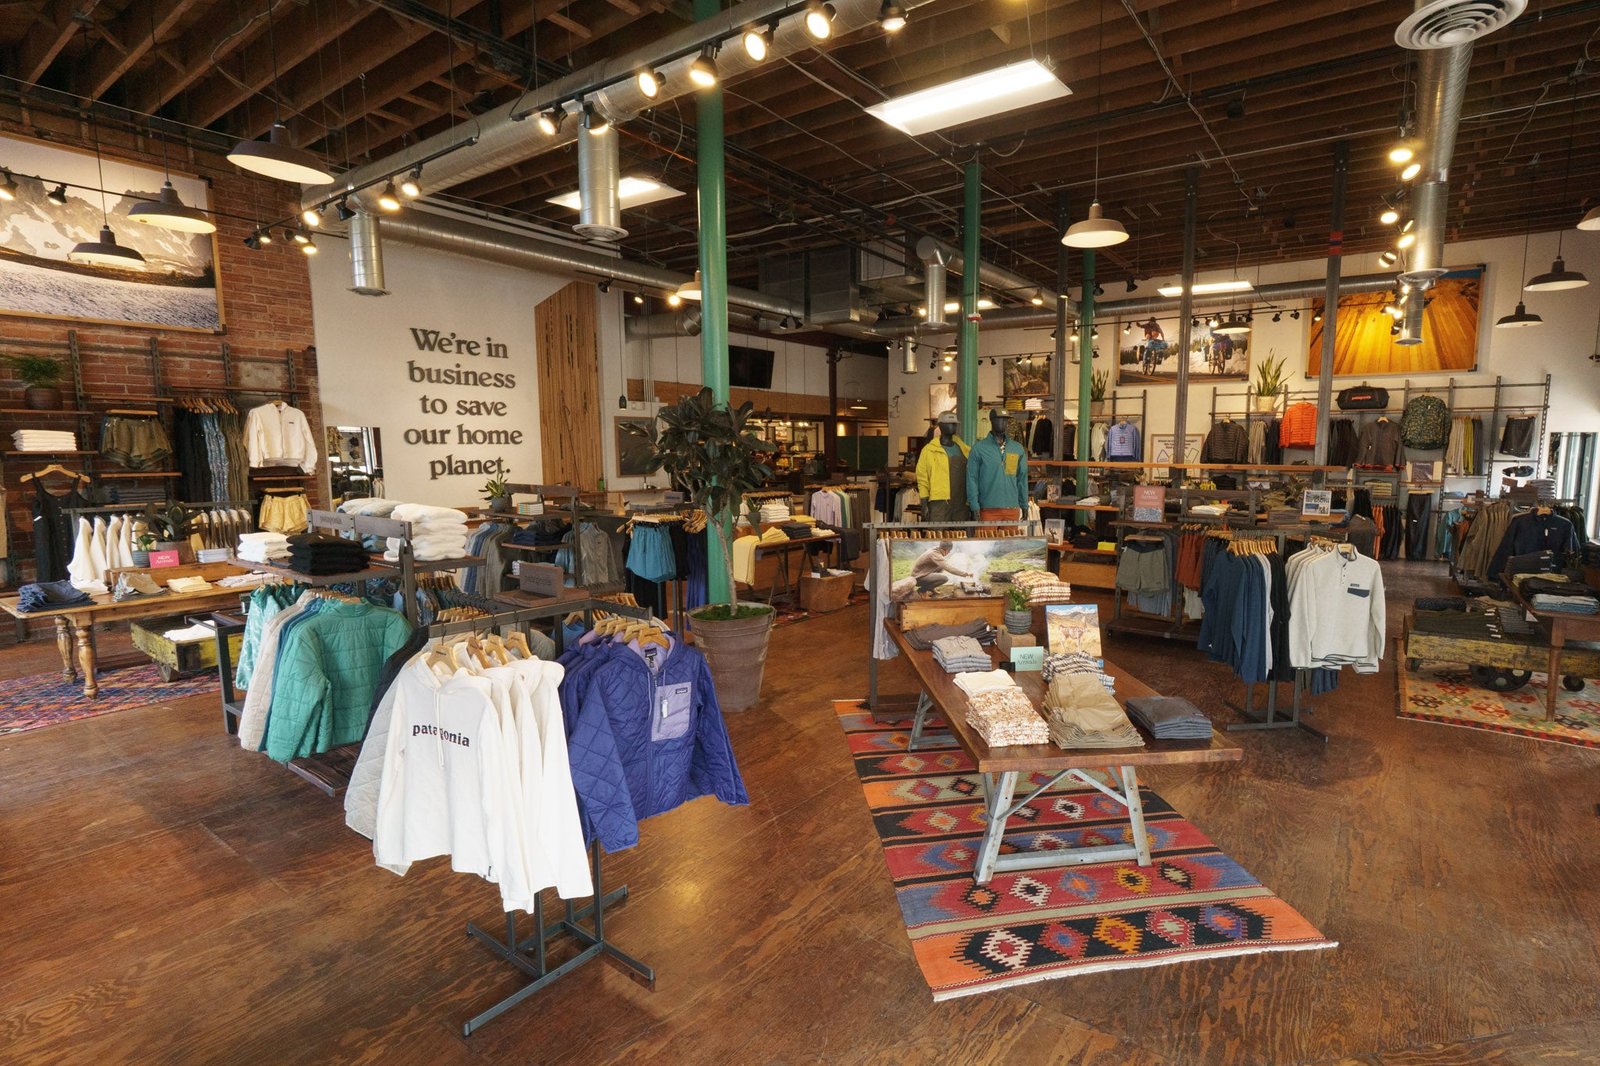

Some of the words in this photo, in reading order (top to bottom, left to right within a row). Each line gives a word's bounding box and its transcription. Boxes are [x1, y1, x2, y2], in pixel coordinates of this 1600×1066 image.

[410, 328, 480, 356] We're
[486, 337, 508, 359] in
[407, 360, 516, 389] business
[420, 395, 448, 414] to
[456, 400, 508, 416] save
[404, 428, 450, 445] our
[457, 424, 523, 445] home
[429, 455, 511, 480] planet.
